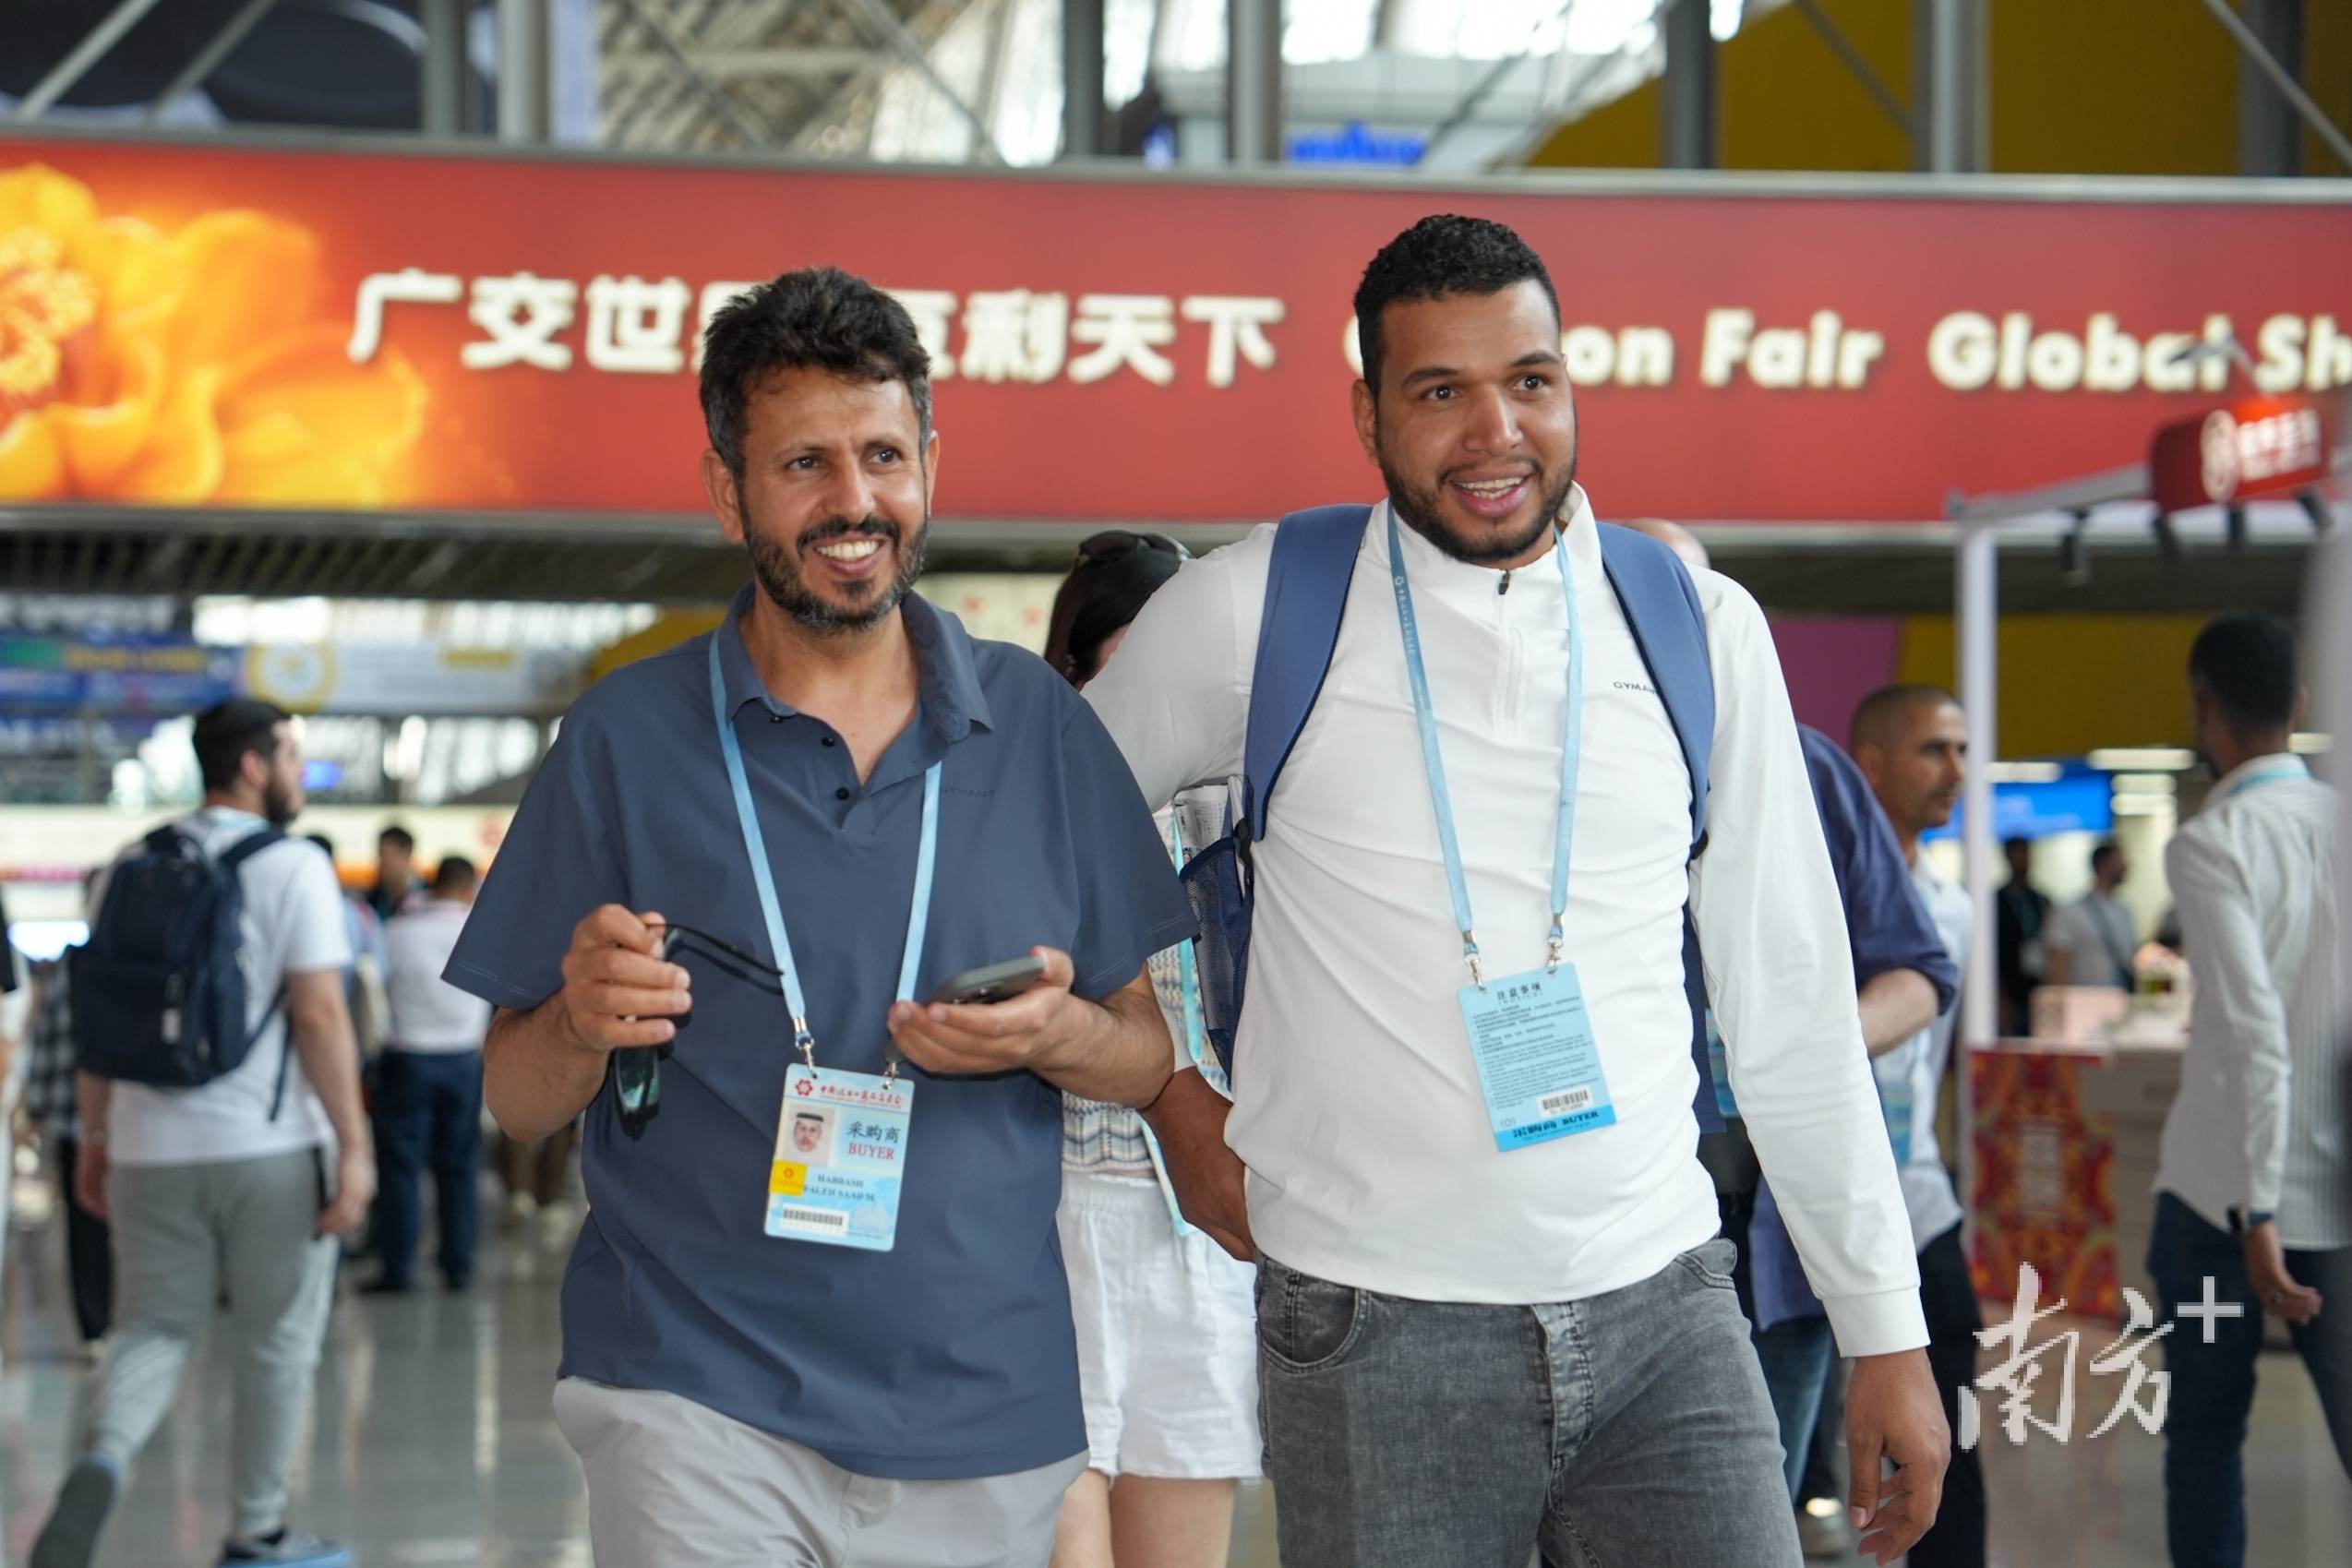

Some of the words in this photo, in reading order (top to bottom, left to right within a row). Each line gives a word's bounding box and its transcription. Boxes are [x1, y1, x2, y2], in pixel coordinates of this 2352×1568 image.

[346, 267, 774, 375] 广交世
[1698, 307, 1884, 389] Fair
[1562, 1110, 1601, 1125] BUYER
[846, 1120, 902, 1144] 采购商
[847, 1142, 895, 1160] BUYER
